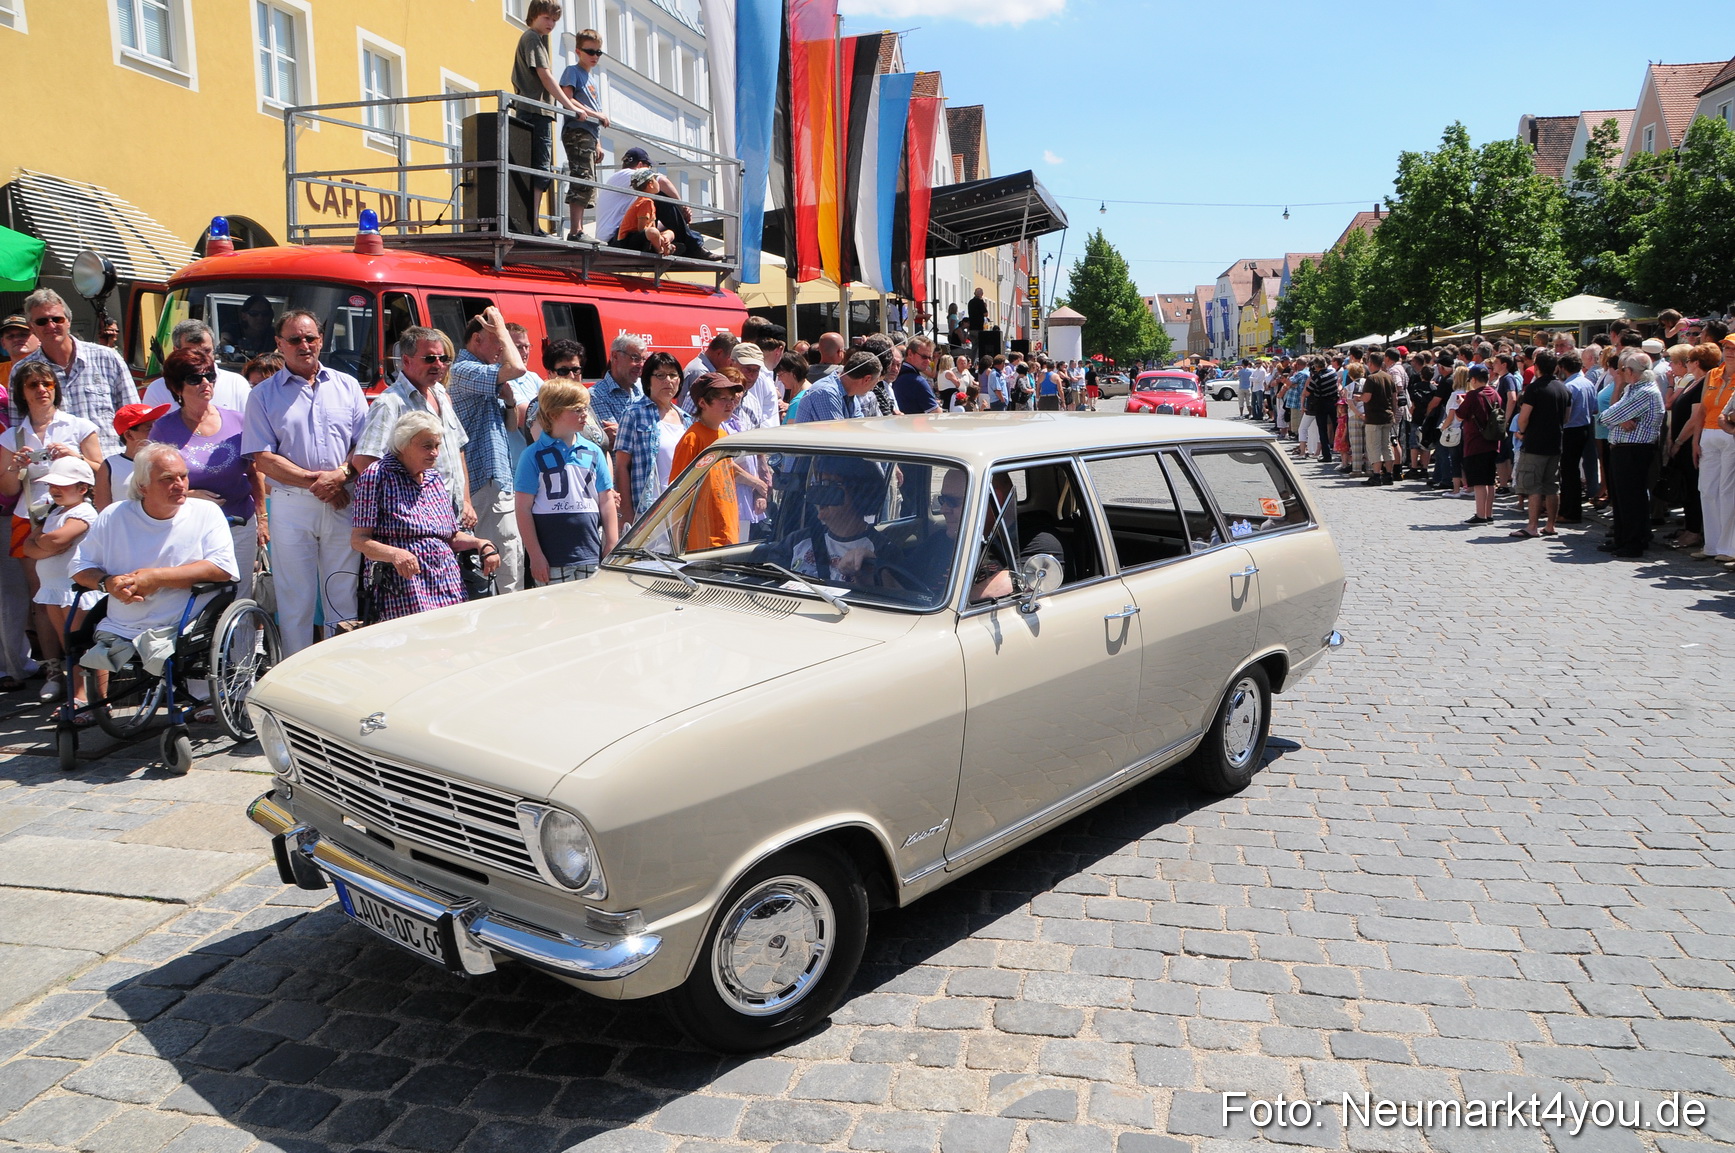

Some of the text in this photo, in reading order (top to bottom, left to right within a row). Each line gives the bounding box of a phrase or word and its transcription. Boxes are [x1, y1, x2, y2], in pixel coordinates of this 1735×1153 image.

[1029, 277, 1039, 328] HOTEL
[535, 446, 598, 500] 87
[347, 888, 385, 931] LAU
[393, 913, 421, 949] OC
